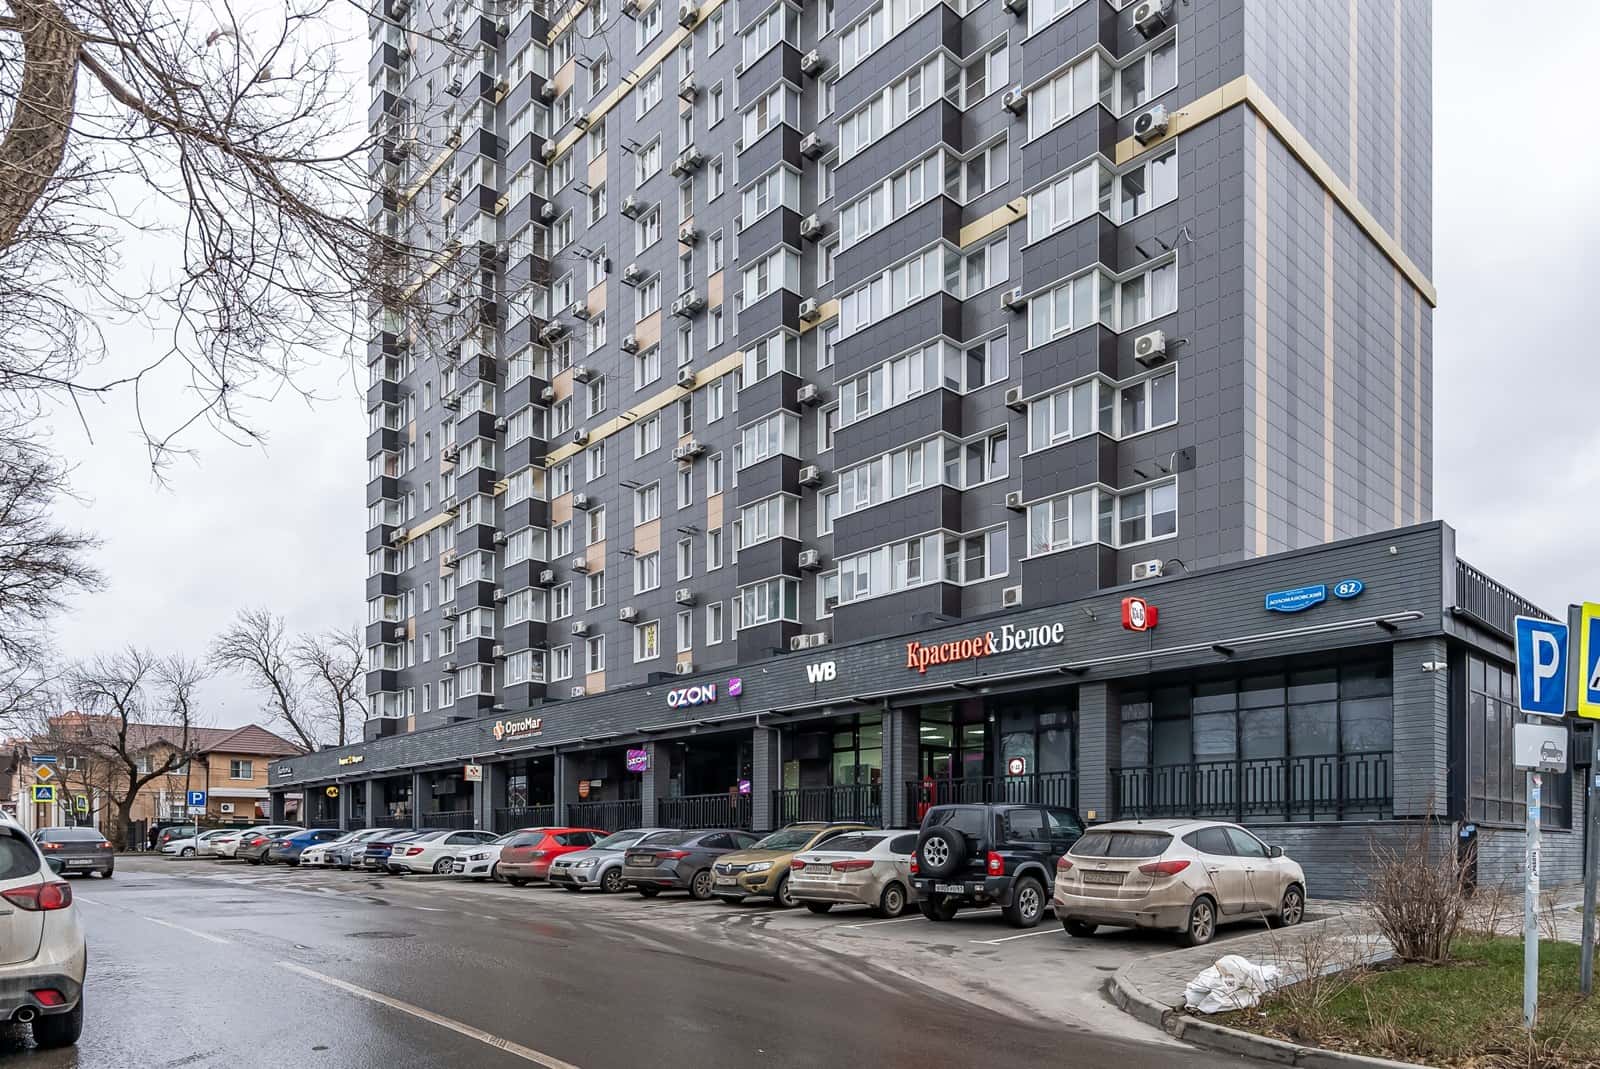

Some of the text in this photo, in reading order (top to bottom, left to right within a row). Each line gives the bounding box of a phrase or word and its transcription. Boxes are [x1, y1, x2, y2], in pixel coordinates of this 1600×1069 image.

[1339, 583, 1356, 595] 82
[806, 661, 837, 684] WB
[1532, 630, 1560, 702] P
[667, 683, 718, 708] OZON
[505, 717, 542, 736] ОртоМаг
[192, 792, 203, 805] P
